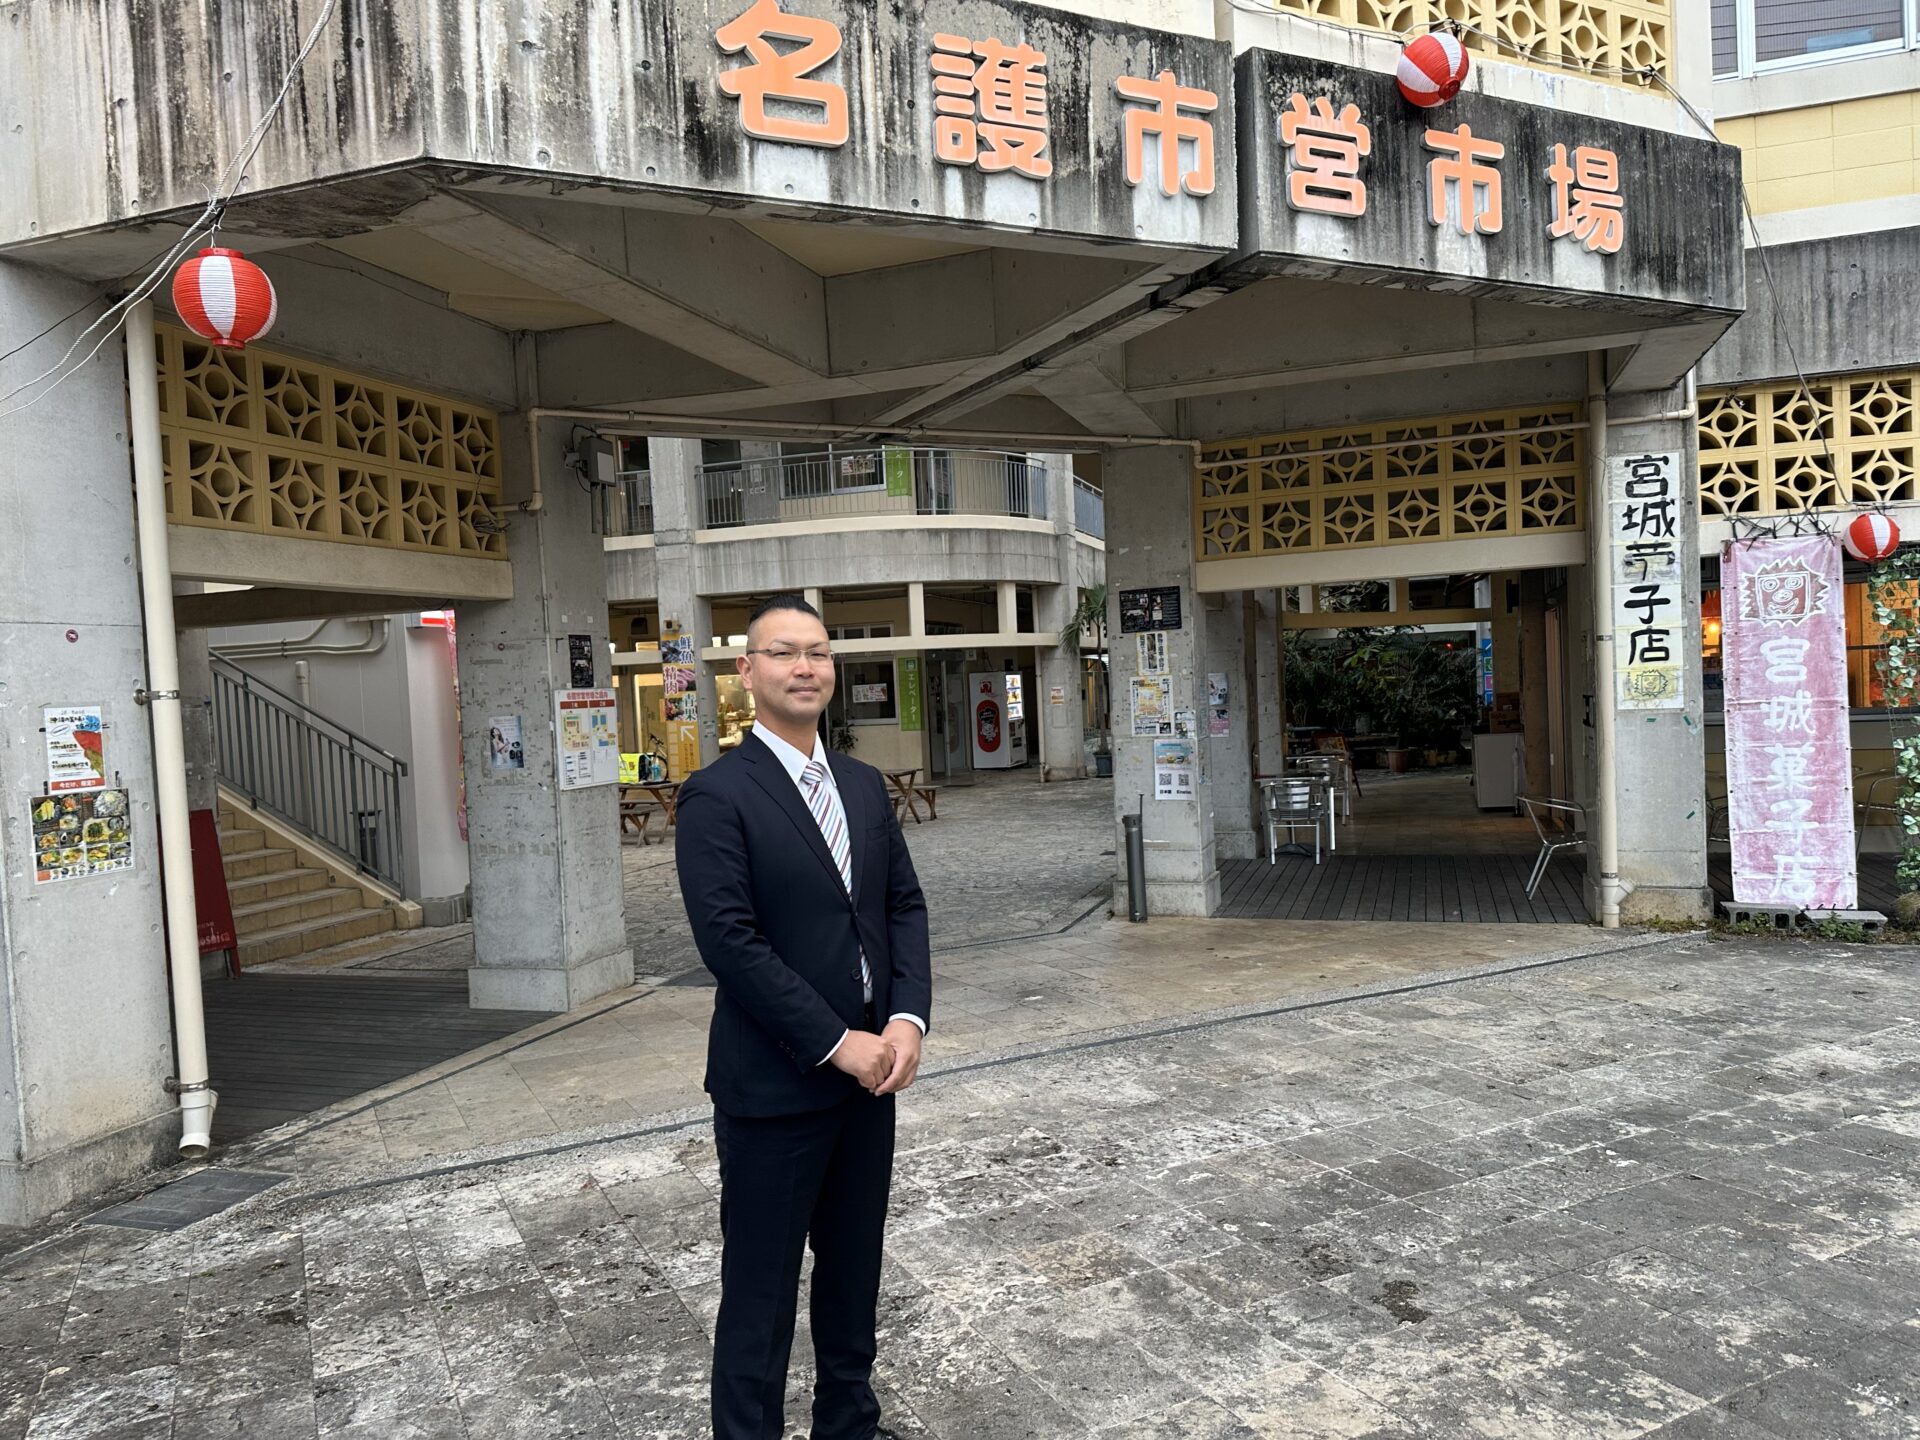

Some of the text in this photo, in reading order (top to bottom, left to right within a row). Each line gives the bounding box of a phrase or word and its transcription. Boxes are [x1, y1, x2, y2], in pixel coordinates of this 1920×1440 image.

[680, 635, 695, 665] 鮮魚
[663, 665, 679, 696] 精肉
[683, 693, 697, 722] 青果
[907, 674, 918, 721] エレベーター
[1758, 636, 1820, 900] 宮城菓子店
